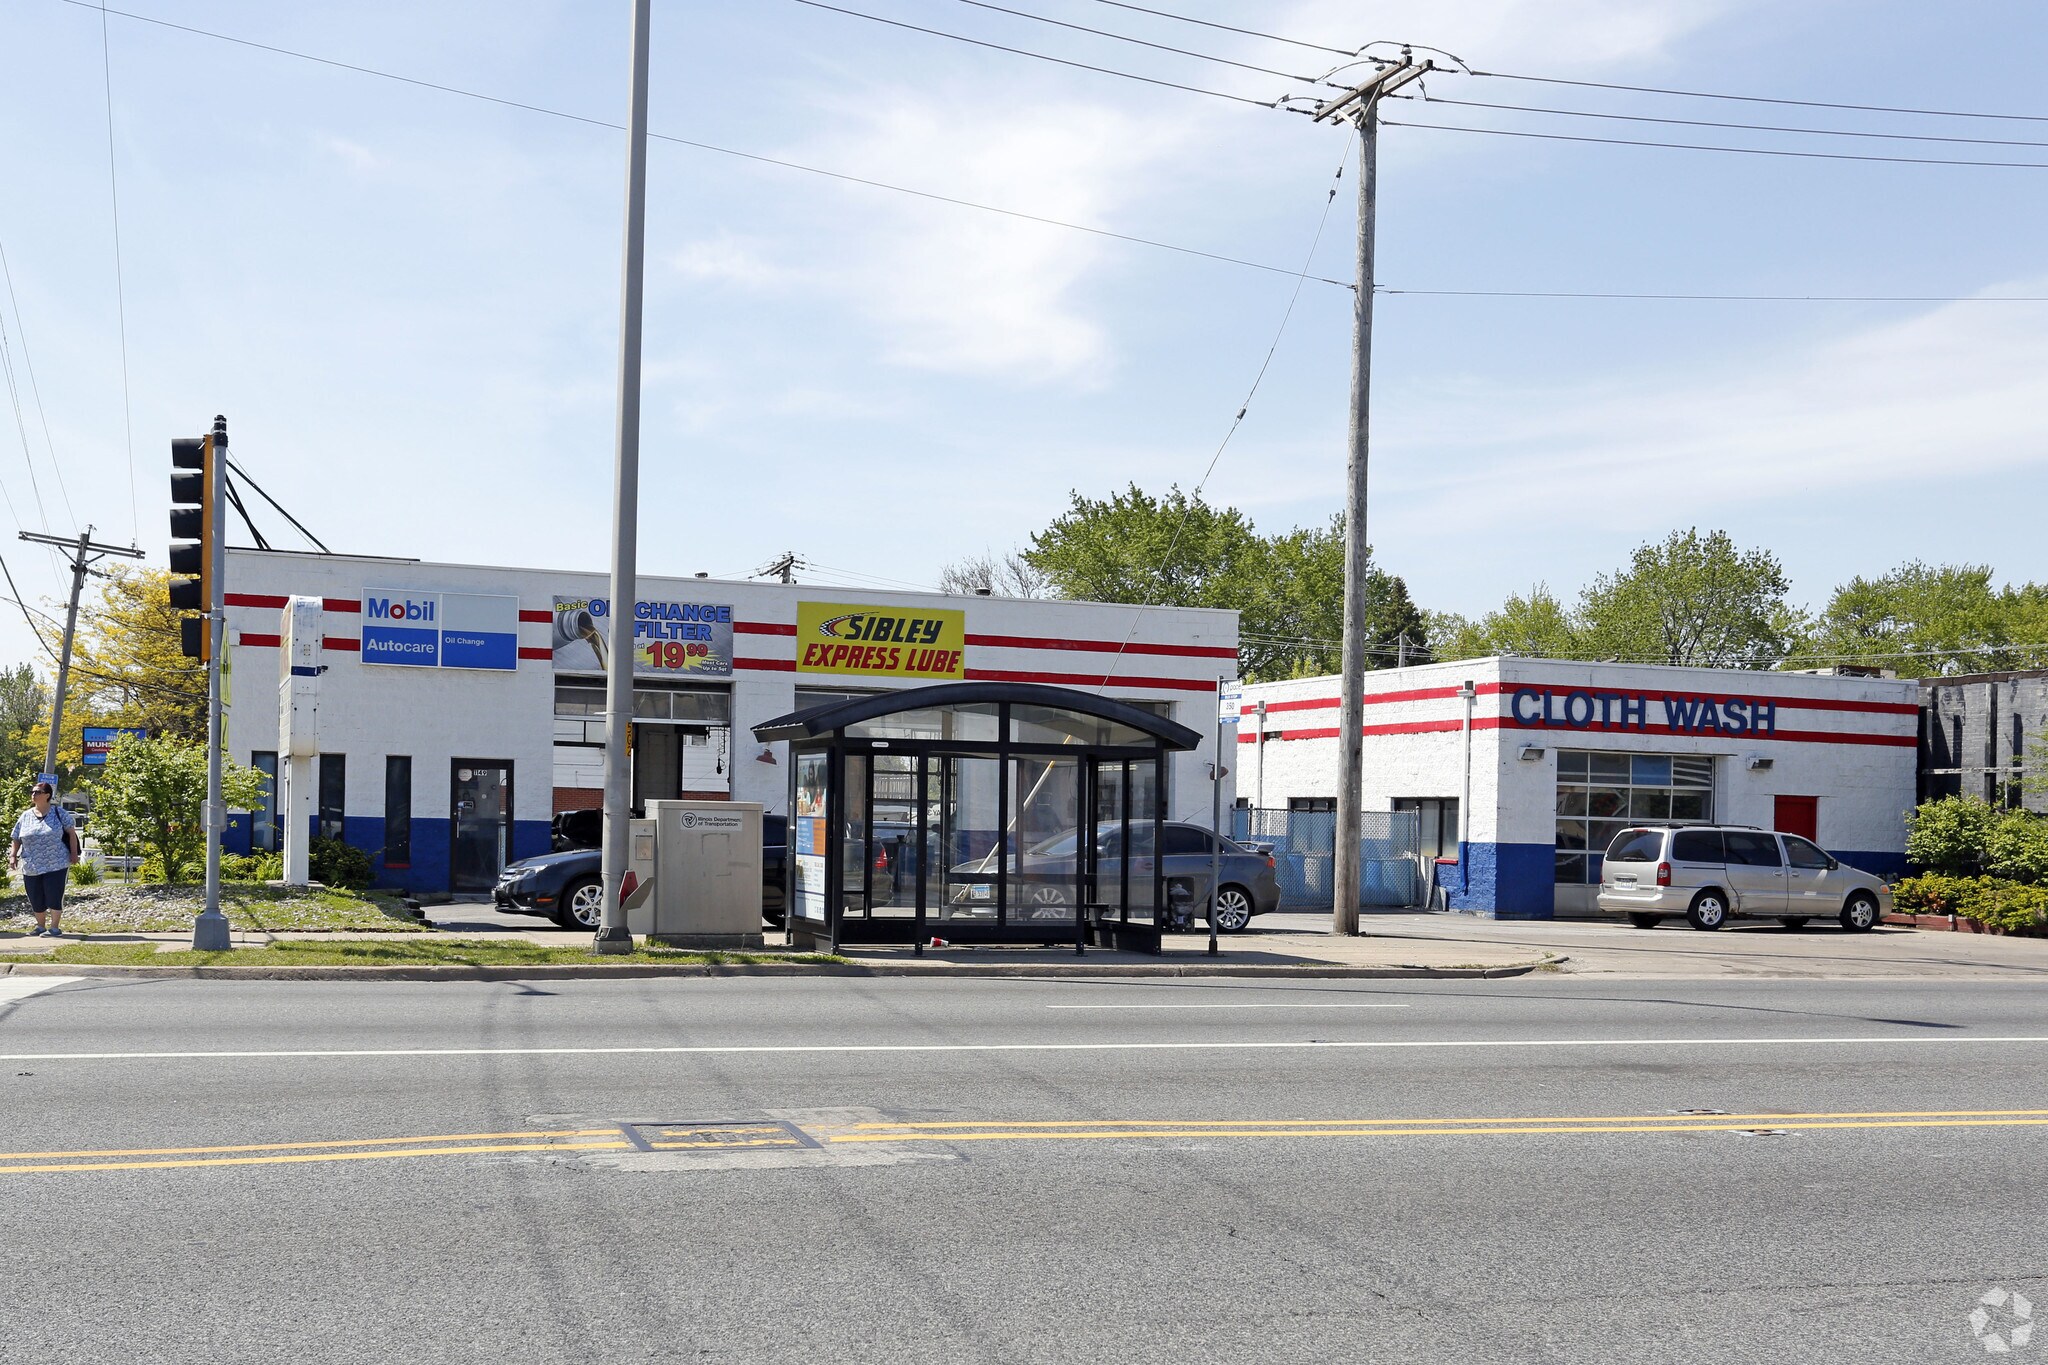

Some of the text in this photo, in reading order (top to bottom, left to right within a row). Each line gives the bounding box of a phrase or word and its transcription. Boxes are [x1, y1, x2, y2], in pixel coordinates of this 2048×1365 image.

[368, 598, 435, 621] Mobil
[555, 600, 588, 612] Basic
[634, 601, 731, 623] CHANGE
[445, 636, 485, 646] Oil Change
[633, 620, 713, 642] FILTER
[844, 616, 943, 644] SIBLEY
[367, 638, 435, 653] Autocare
[802, 643, 962, 673] EXPRESS LUBE
[1511, 688, 1776, 735] CLOTH WASH
